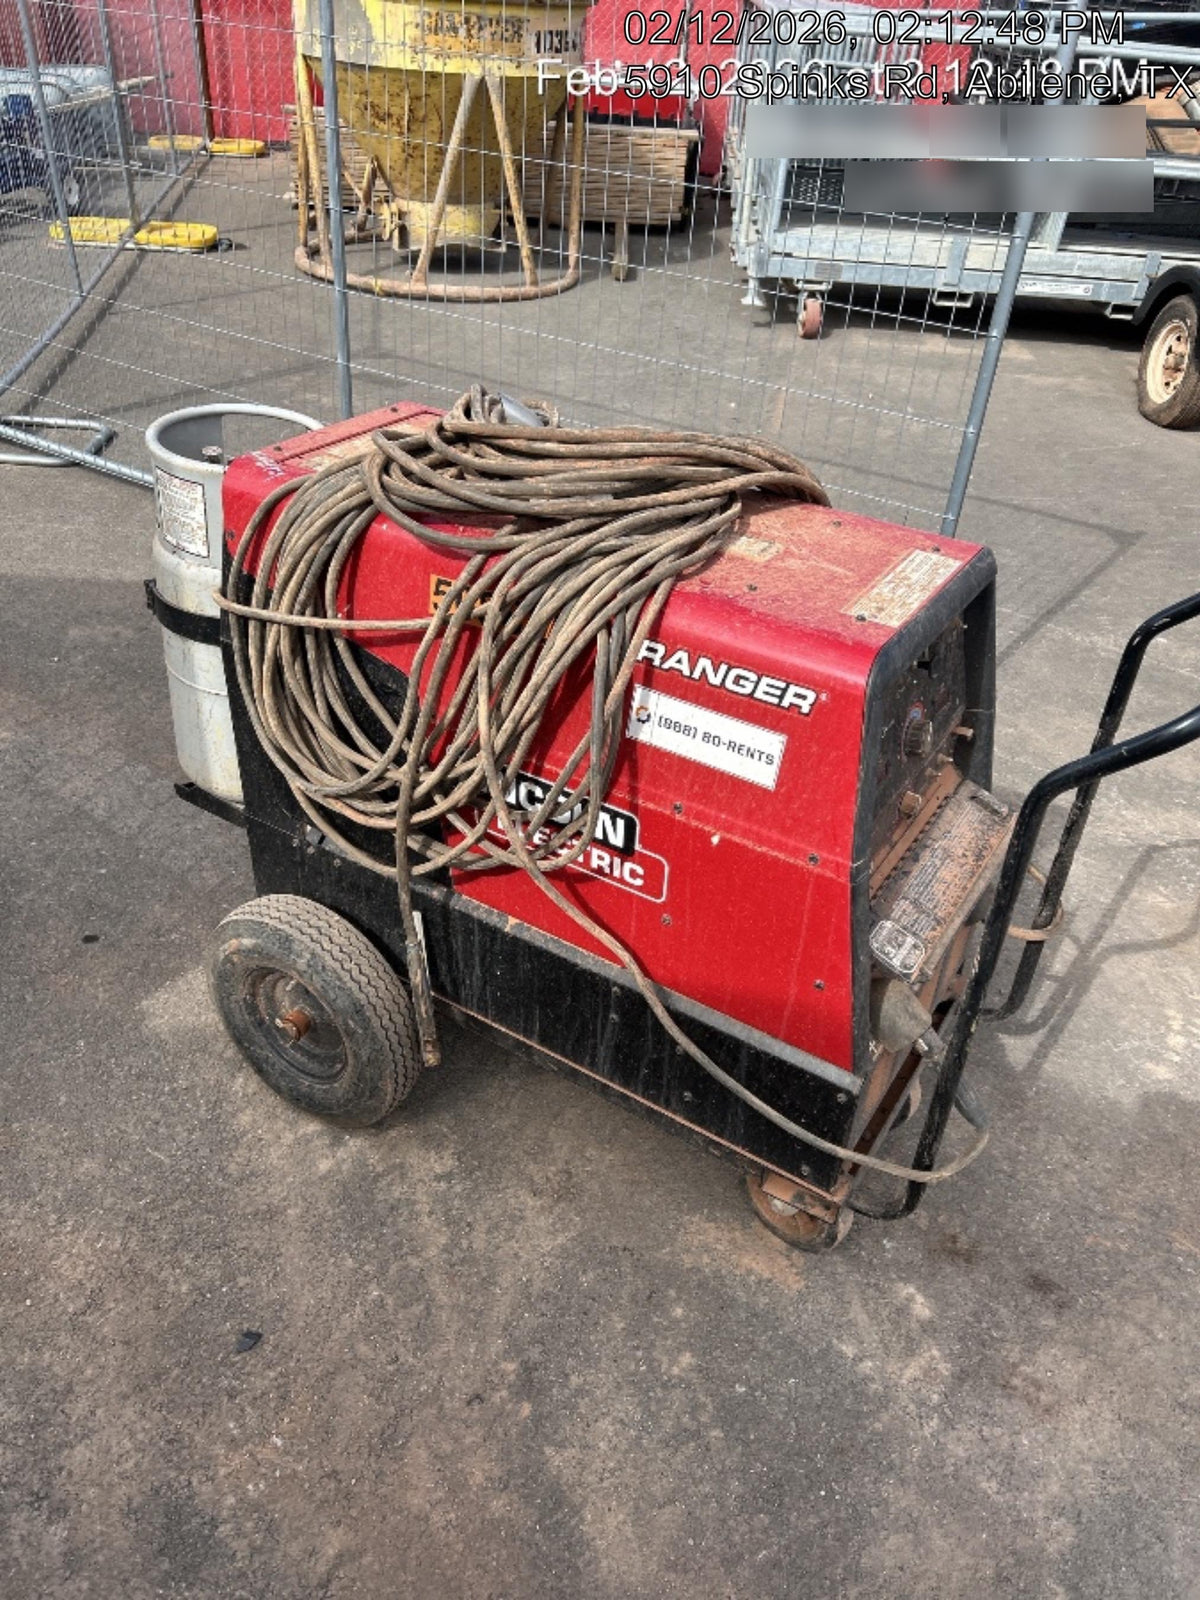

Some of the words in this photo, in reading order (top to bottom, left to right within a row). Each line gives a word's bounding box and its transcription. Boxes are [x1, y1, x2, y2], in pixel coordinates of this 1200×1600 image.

[635, 638, 818, 715] RANGER
[657, 714, 698, 740] (888)
[701, 730, 776, 766] 80-RENTS
